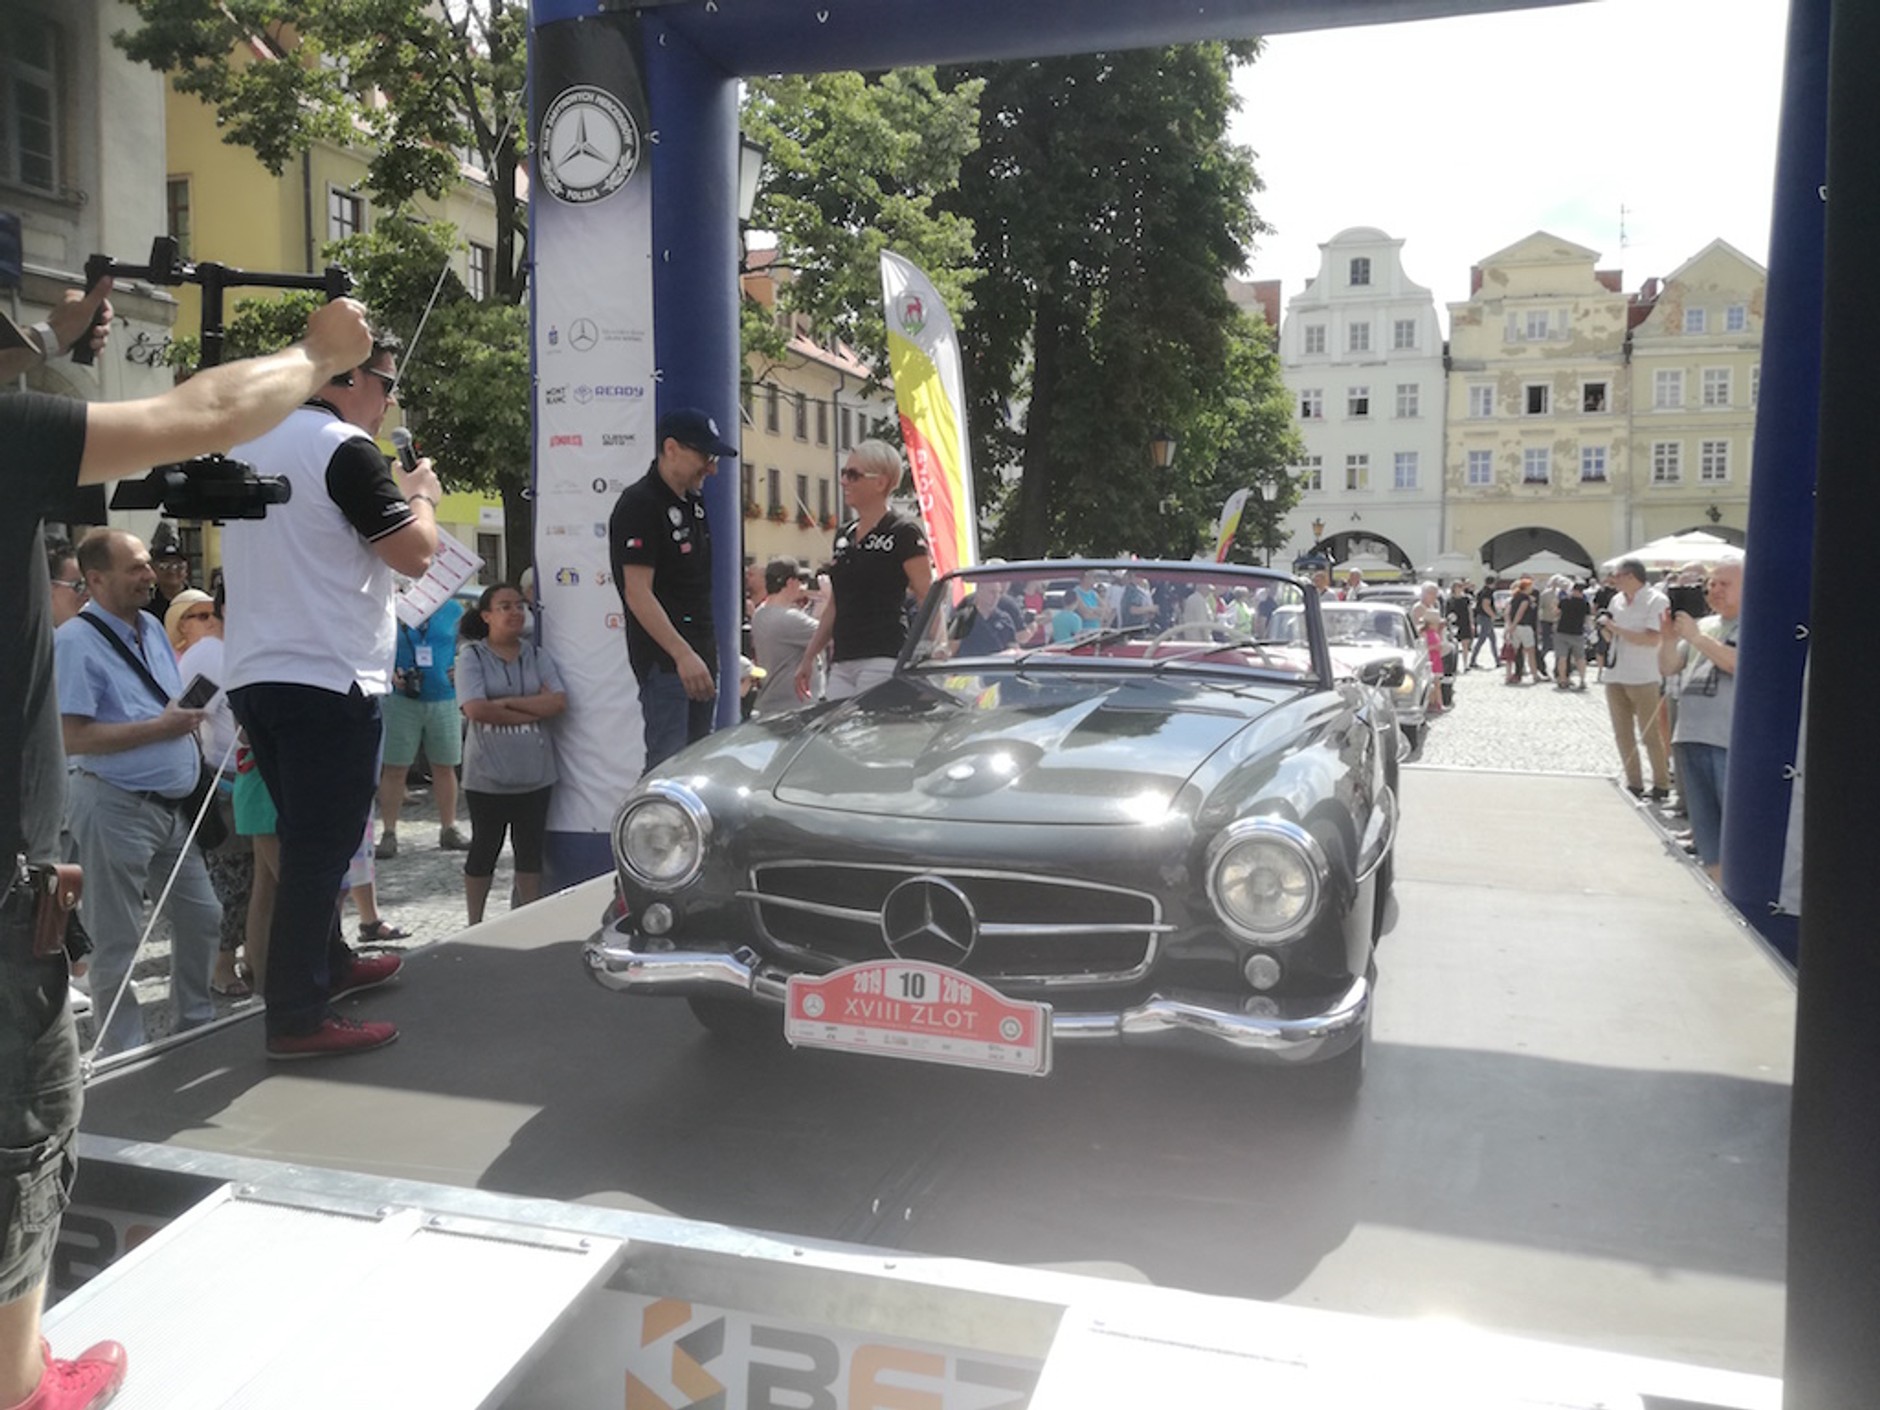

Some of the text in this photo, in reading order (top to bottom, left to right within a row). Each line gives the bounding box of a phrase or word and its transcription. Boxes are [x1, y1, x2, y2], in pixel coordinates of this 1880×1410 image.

[566, 188, 600, 201] POLSKA
[595, 385, 644, 398] READY
[865, 534, 895, 552] 366
[853, 968, 973, 1006] 2019 10 2019
[844, 998, 900, 1022] XVIII
[910, 1006, 979, 1030] ZLOT
